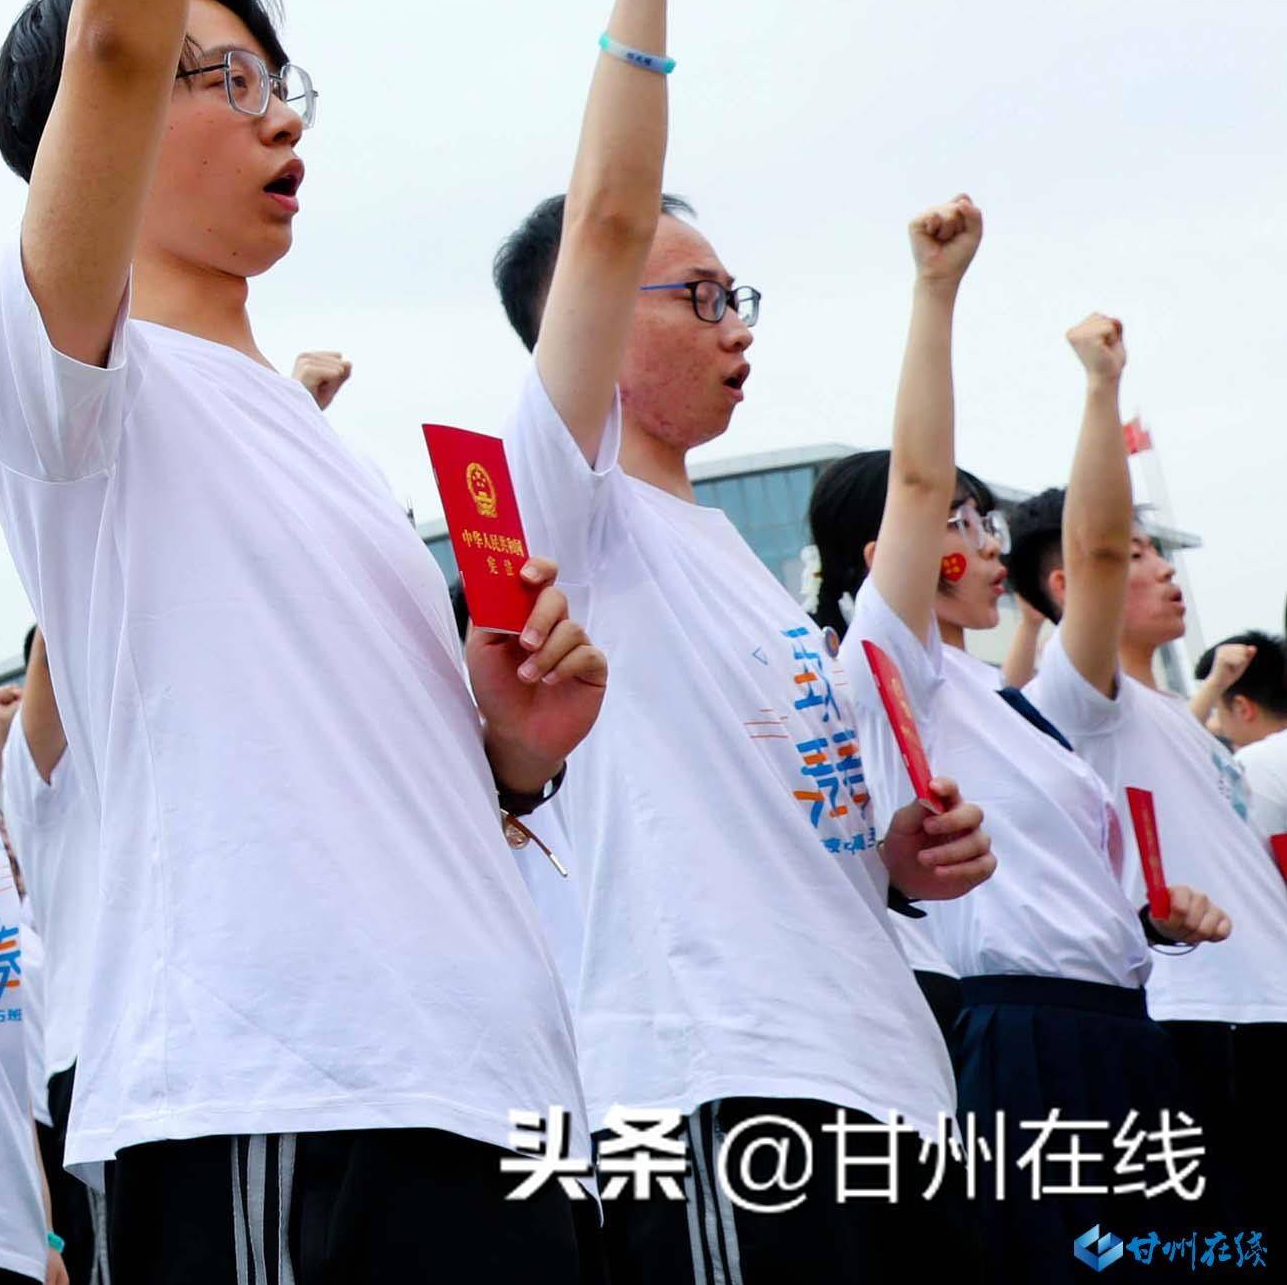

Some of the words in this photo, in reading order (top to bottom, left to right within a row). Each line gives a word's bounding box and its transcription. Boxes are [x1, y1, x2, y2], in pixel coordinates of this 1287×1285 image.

[461, 528, 525, 558] 中华人民共和国
